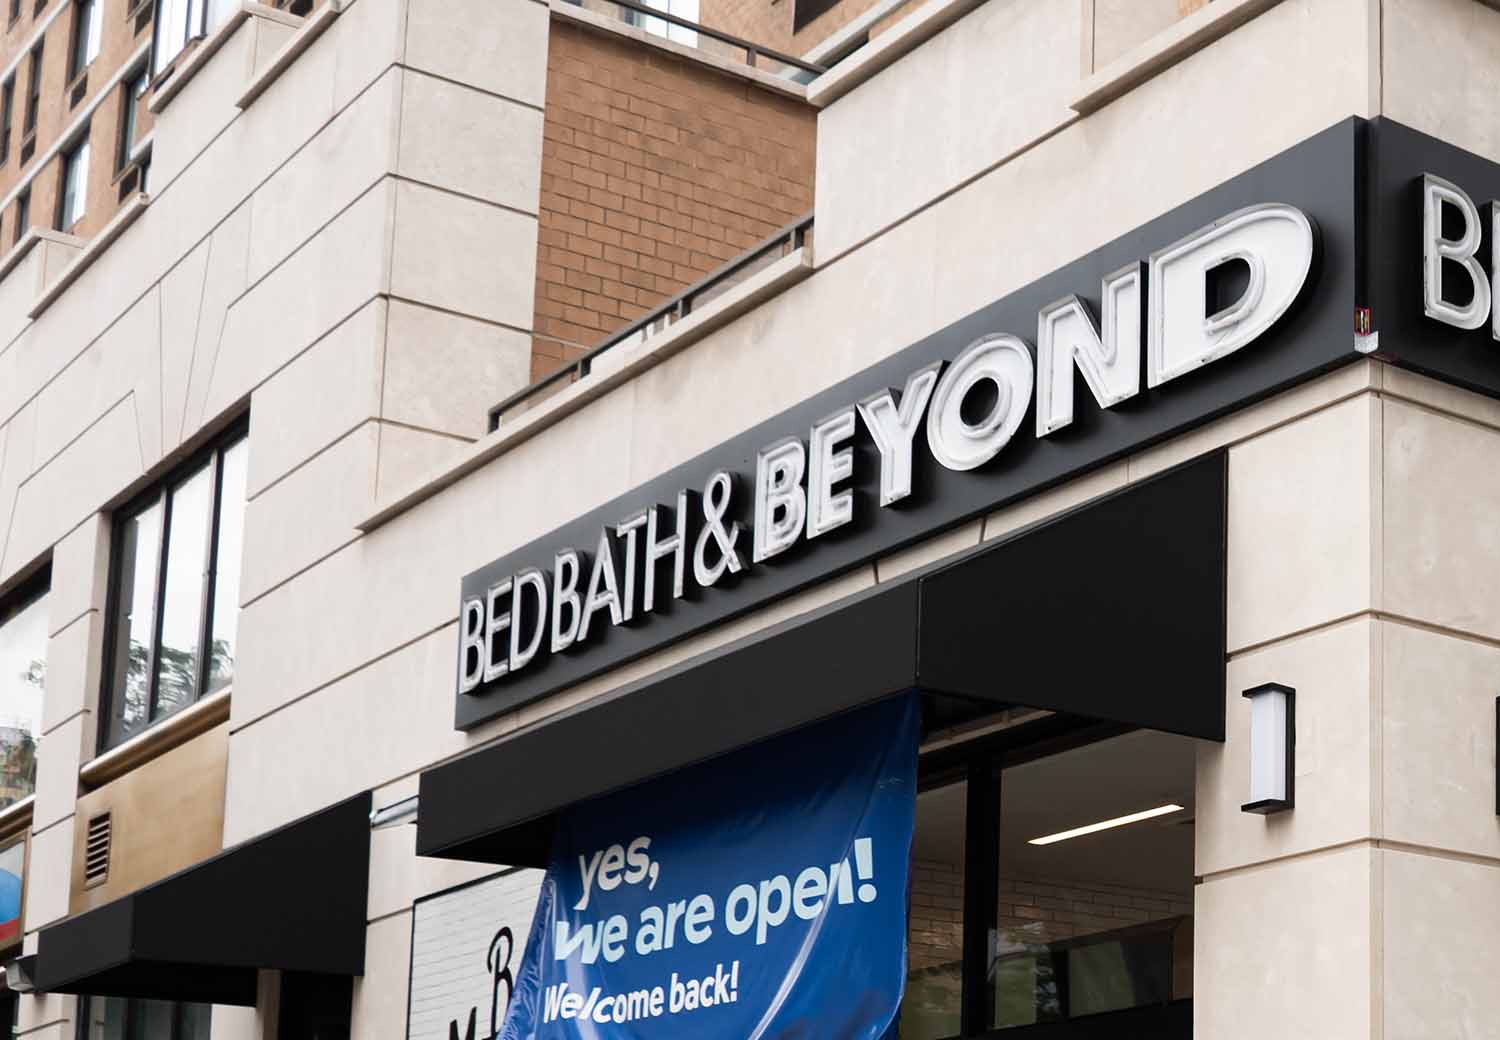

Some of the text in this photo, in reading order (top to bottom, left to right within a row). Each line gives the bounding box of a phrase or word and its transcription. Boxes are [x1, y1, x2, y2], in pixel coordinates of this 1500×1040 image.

[459, 202, 1320, 695] BED BATH & BEYOND
[554, 837, 877, 964] we are open!
[573, 836, 660, 911] yes,
[543, 960, 740, 1024] Welcome back!
